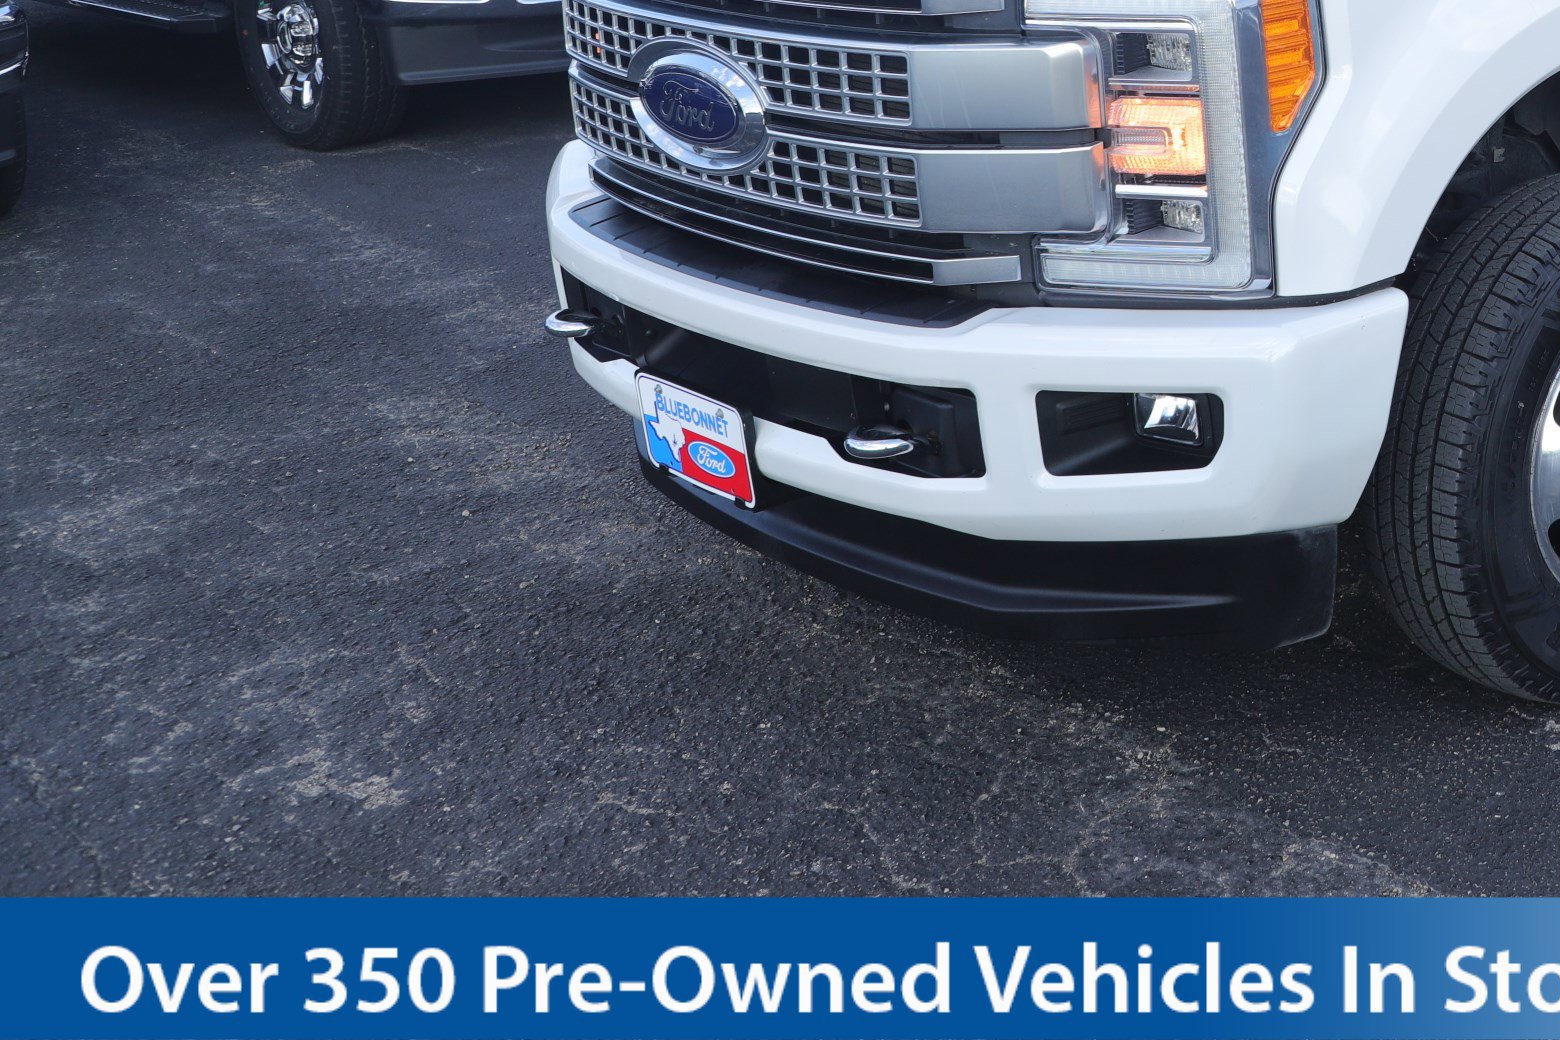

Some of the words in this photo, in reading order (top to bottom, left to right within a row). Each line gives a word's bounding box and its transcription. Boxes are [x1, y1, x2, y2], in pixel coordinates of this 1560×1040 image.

[659, 79, 715, 133] Ford
[655, 392, 729, 439] BLUEBONNET
[697, 445, 727, 474] Ford
